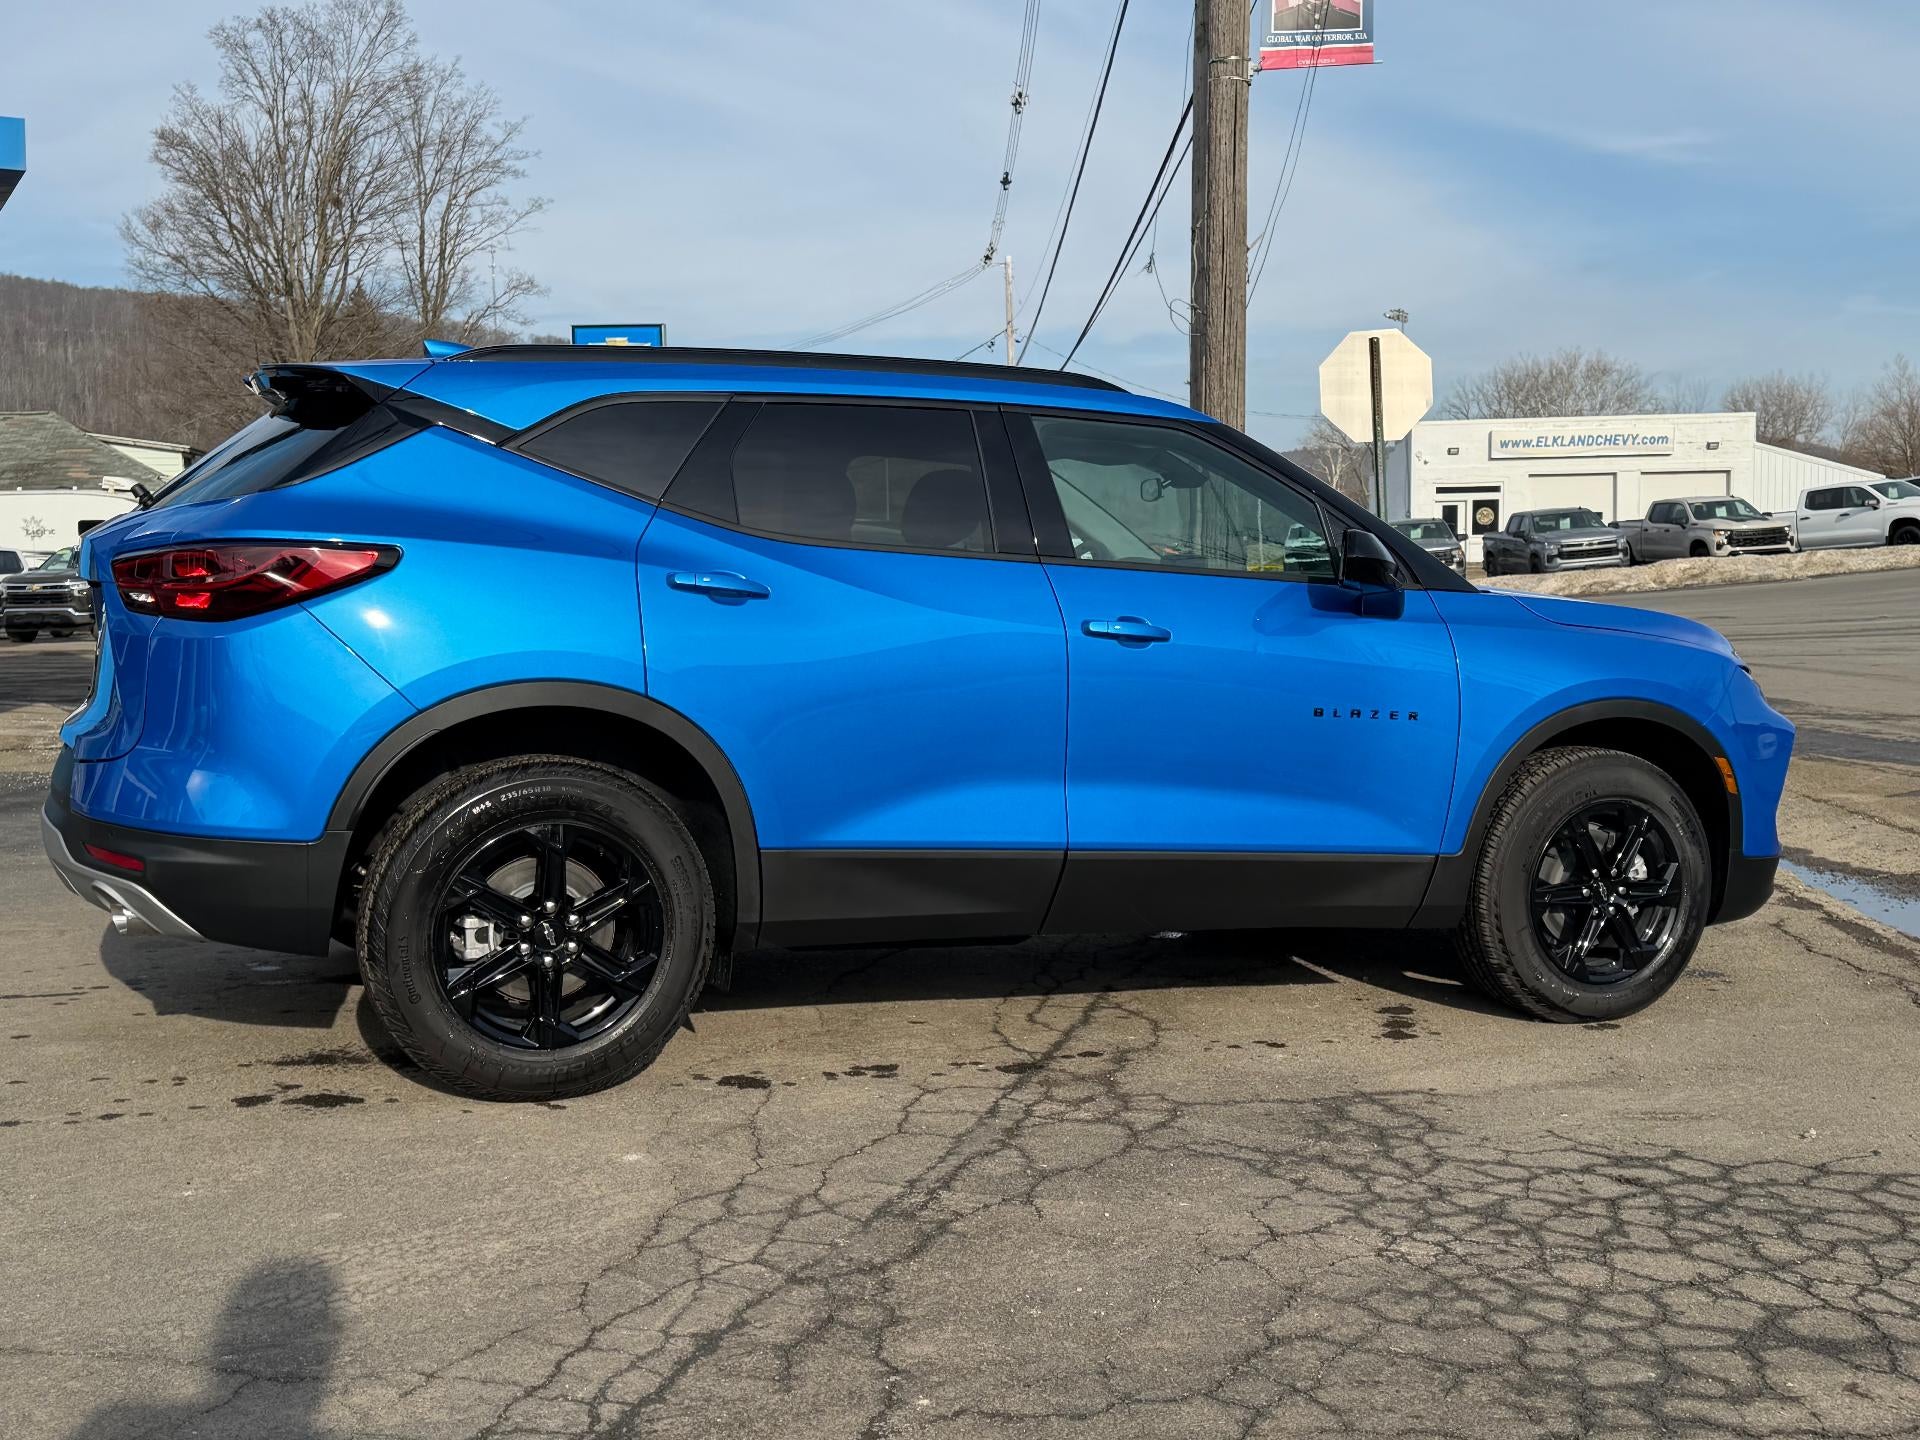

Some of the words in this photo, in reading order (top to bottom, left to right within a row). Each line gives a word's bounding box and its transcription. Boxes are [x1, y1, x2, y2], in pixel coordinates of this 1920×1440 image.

[1266, 35, 1294, 43] GLOBAL
[1295, 34, 1311, 43] WAR
[1322, 33, 1354, 42] TERROR,
[1355, 32, 1368, 40] KIA
[1500, 433, 1669, 448] www.ELKLANDCHEVY.com
[1313, 707, 1418, 720] BLAZER
